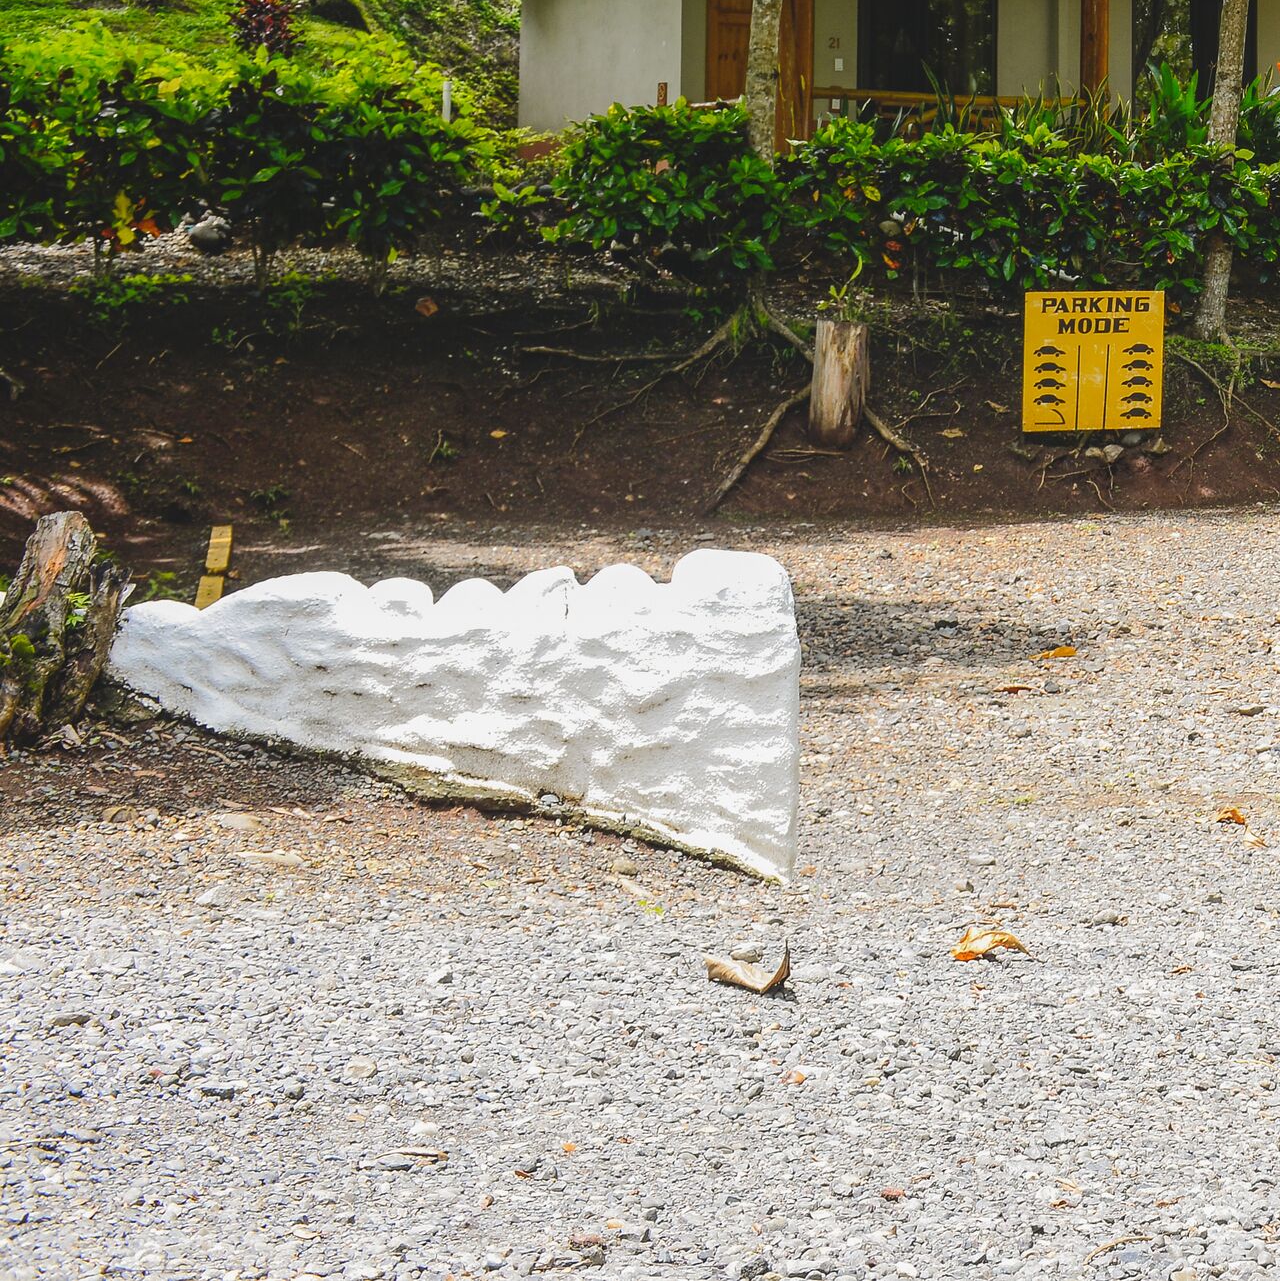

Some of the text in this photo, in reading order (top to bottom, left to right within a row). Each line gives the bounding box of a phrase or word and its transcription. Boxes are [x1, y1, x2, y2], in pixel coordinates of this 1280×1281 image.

[828, 37, 840, 49] 21
[1041, 297, 1150, 313] PARKING
[1057, 317, 1130, 334] MODE
